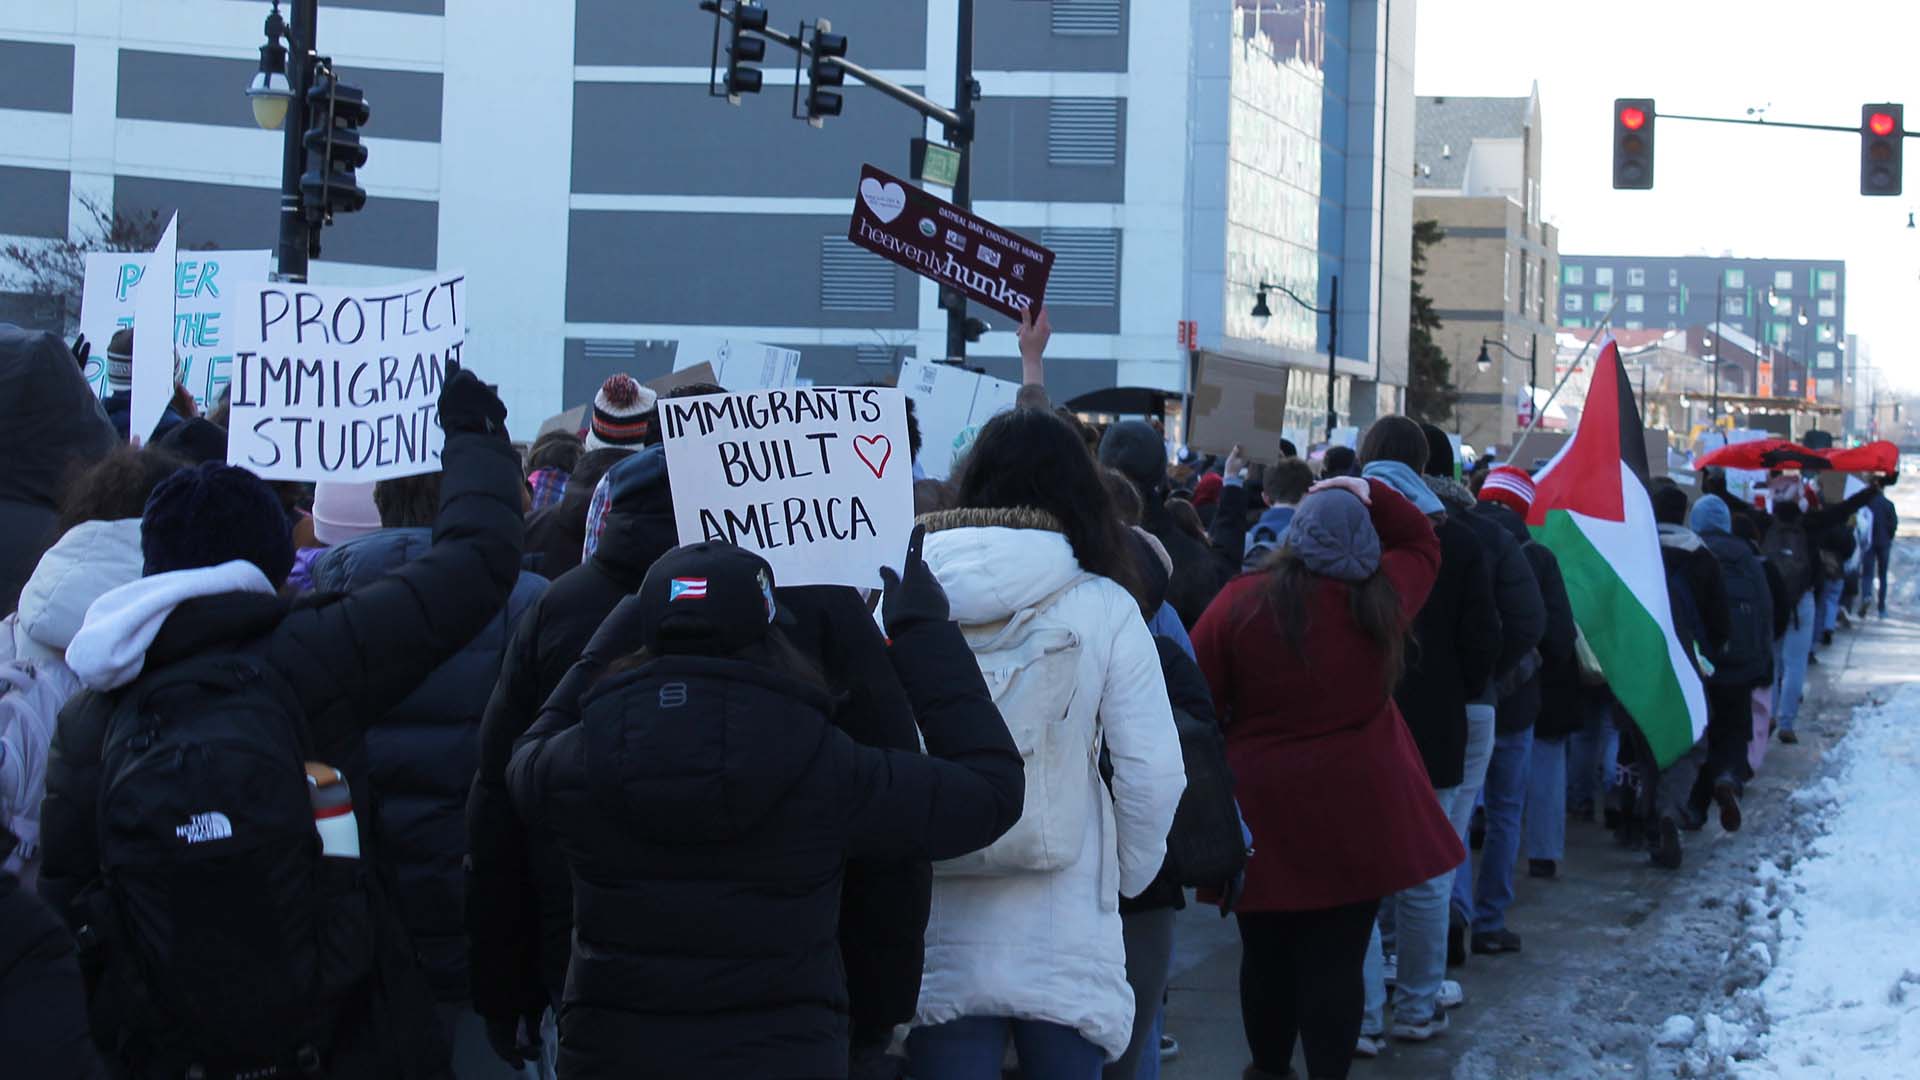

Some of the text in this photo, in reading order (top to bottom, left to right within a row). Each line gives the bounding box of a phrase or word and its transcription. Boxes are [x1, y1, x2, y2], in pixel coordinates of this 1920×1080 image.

[115, 260, 220, 301] PER
[174, 311, 221, 348] THE
[260, 275, 464, 344] PROTECT
[232, 340, 464, 408] IMMIGRANT
[665, 388, 881, 439] IMMIGRANTS
[717, 432, 838, 488] BUILT
[699, 496, 877, 550] AMERICA
[176, 823, 212, 838] NORTH
[187, 831, 212, 844] FACE
